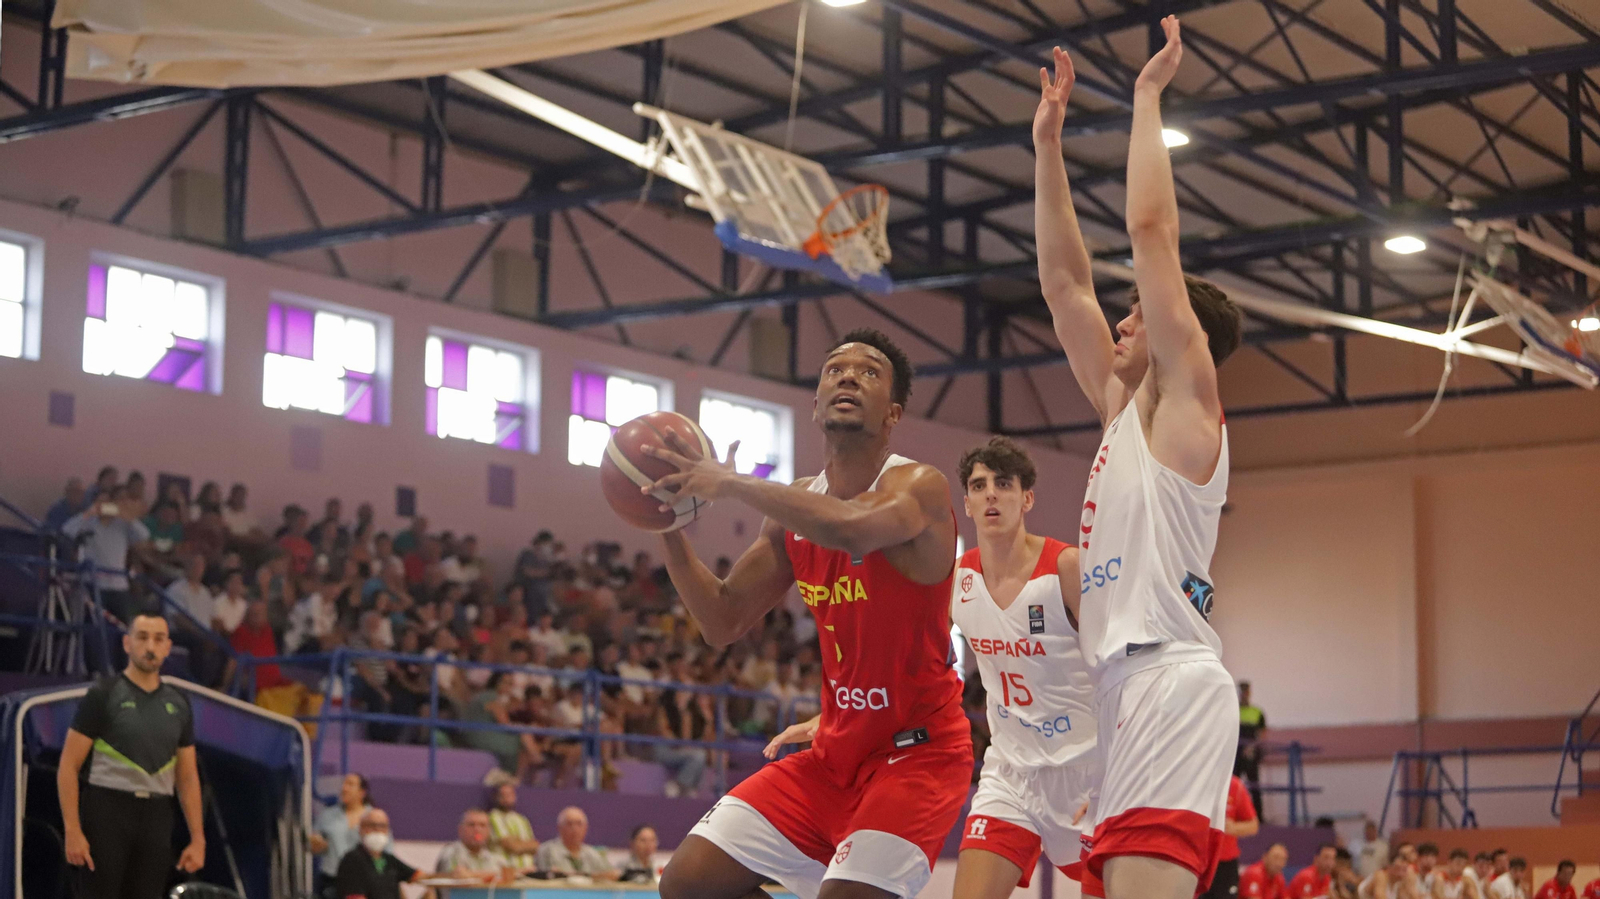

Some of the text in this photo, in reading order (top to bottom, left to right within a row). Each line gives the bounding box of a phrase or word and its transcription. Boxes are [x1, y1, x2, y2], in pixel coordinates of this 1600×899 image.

[970, 638, 1046, 658] ESPAÑA
[828, 679, 889, 710] esa
[1000, 671, 1033, 707] 15
